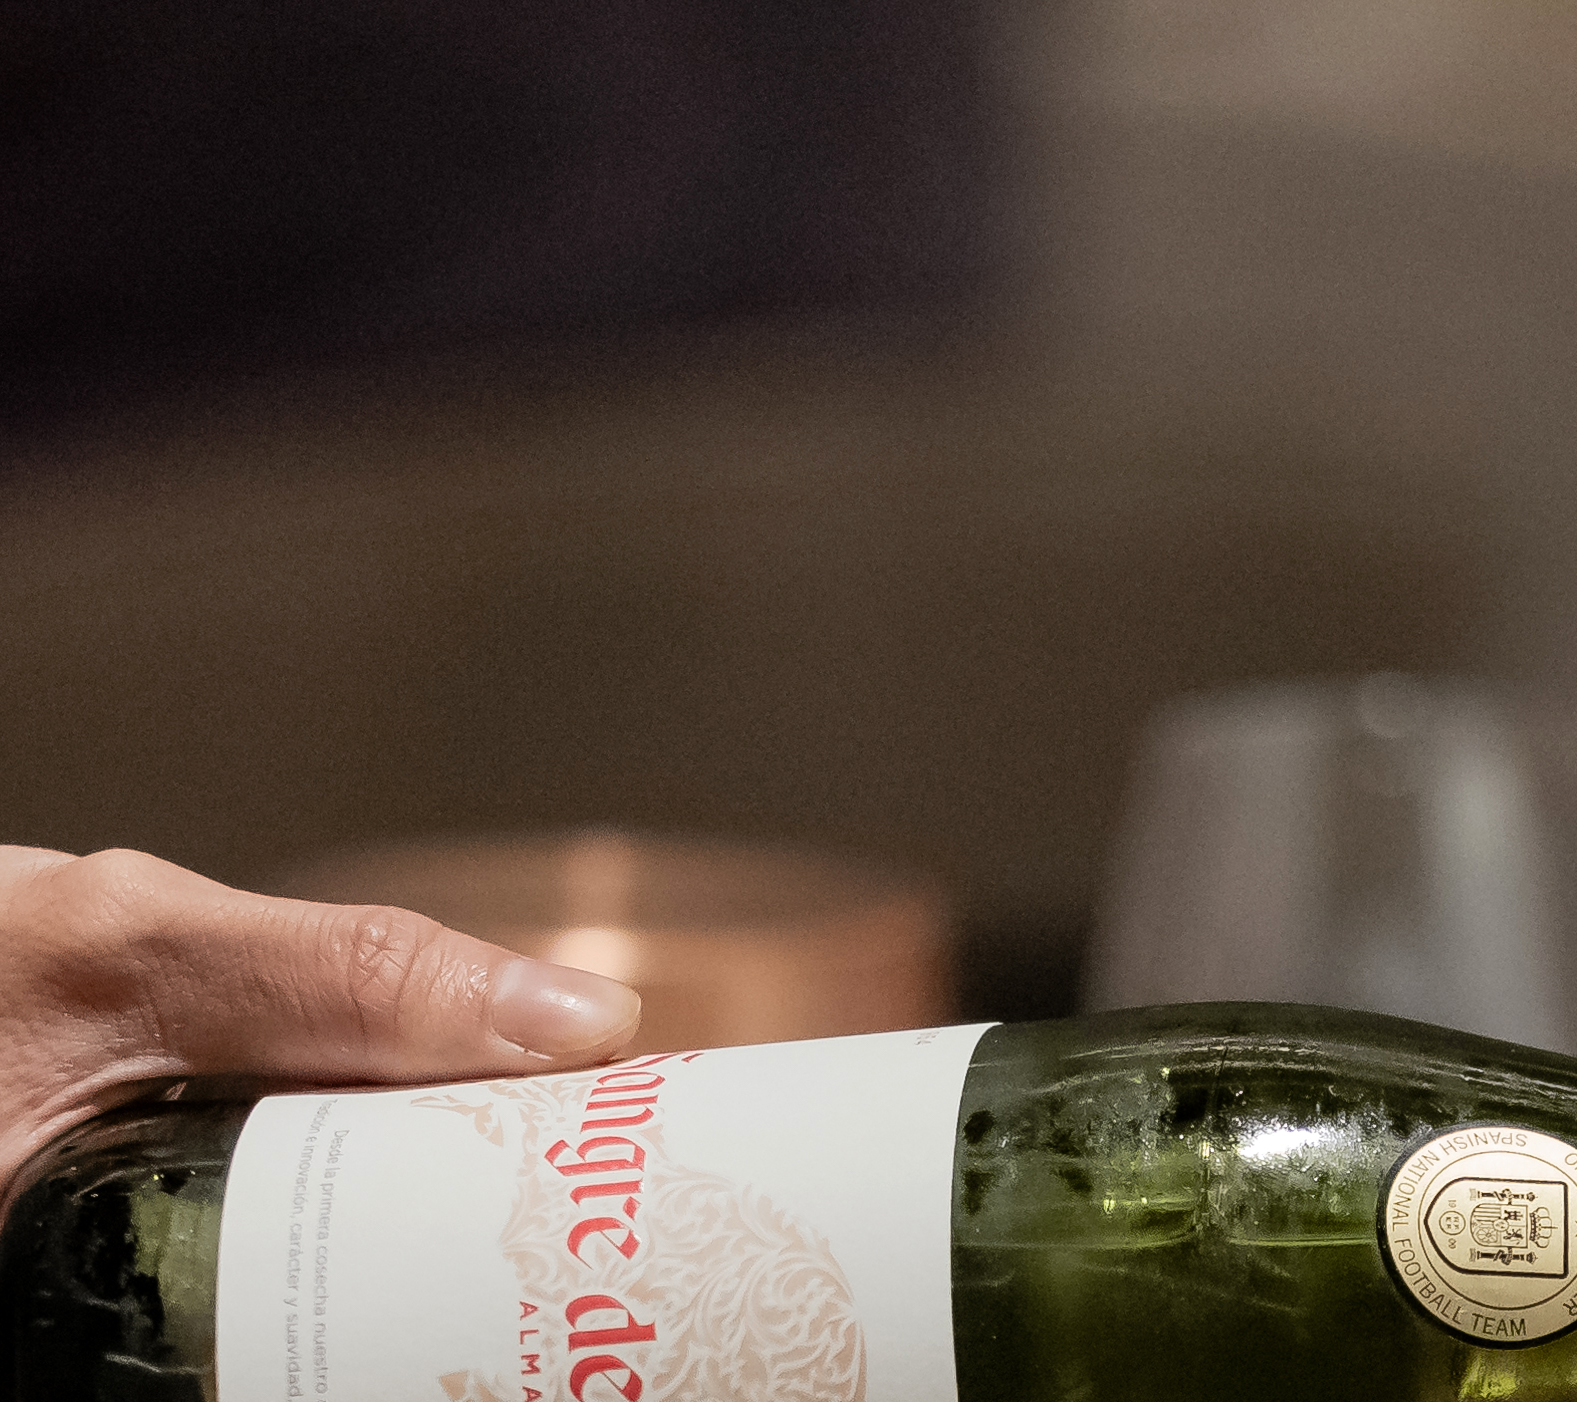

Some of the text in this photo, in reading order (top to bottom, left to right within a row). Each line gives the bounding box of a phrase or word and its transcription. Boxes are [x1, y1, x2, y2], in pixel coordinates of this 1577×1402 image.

[323, 1167, 340, 1179] la
[326, 1129, 350, 1164] Desde
[316, 1183, 335, 1240] primera
[1392, 1131, 1528, 1337] SPANISH NATIONAL FOOTBALL TEAM
[287, 1223, 305, 1290] carácter
[314, 1245, 329, 1316] cosecha
[284, 1297, 300, 1307] y
[313, 1322, 330, 1393] nuestro
